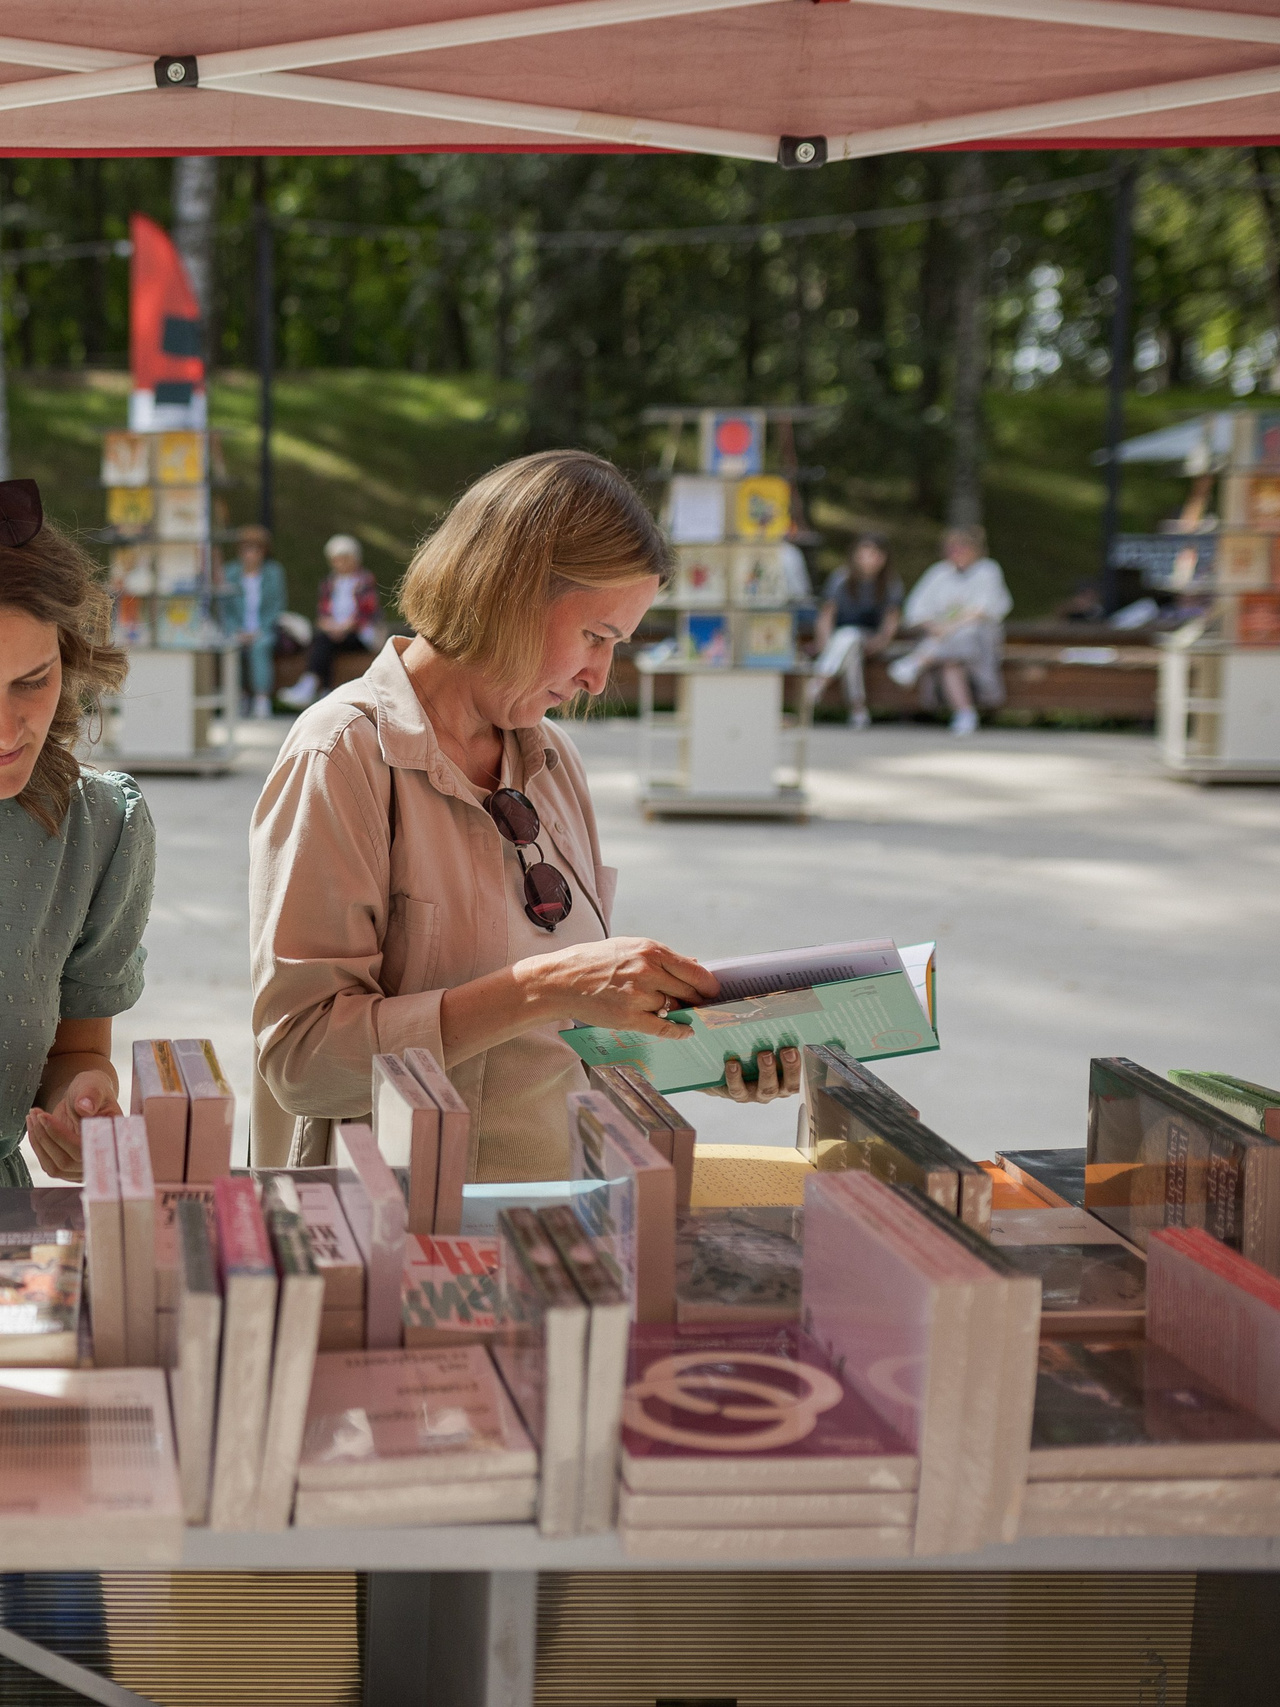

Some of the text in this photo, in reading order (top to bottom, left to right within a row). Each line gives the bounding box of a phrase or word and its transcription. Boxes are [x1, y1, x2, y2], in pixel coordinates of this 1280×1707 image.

[1167, 1127, 1179, 1226] картогра
[1207, 1152, 1220, 1204] Берг
[1214, 1156, 1230, 1240] Рейнер
[1226, 1165, 1238, 1234] Томас
